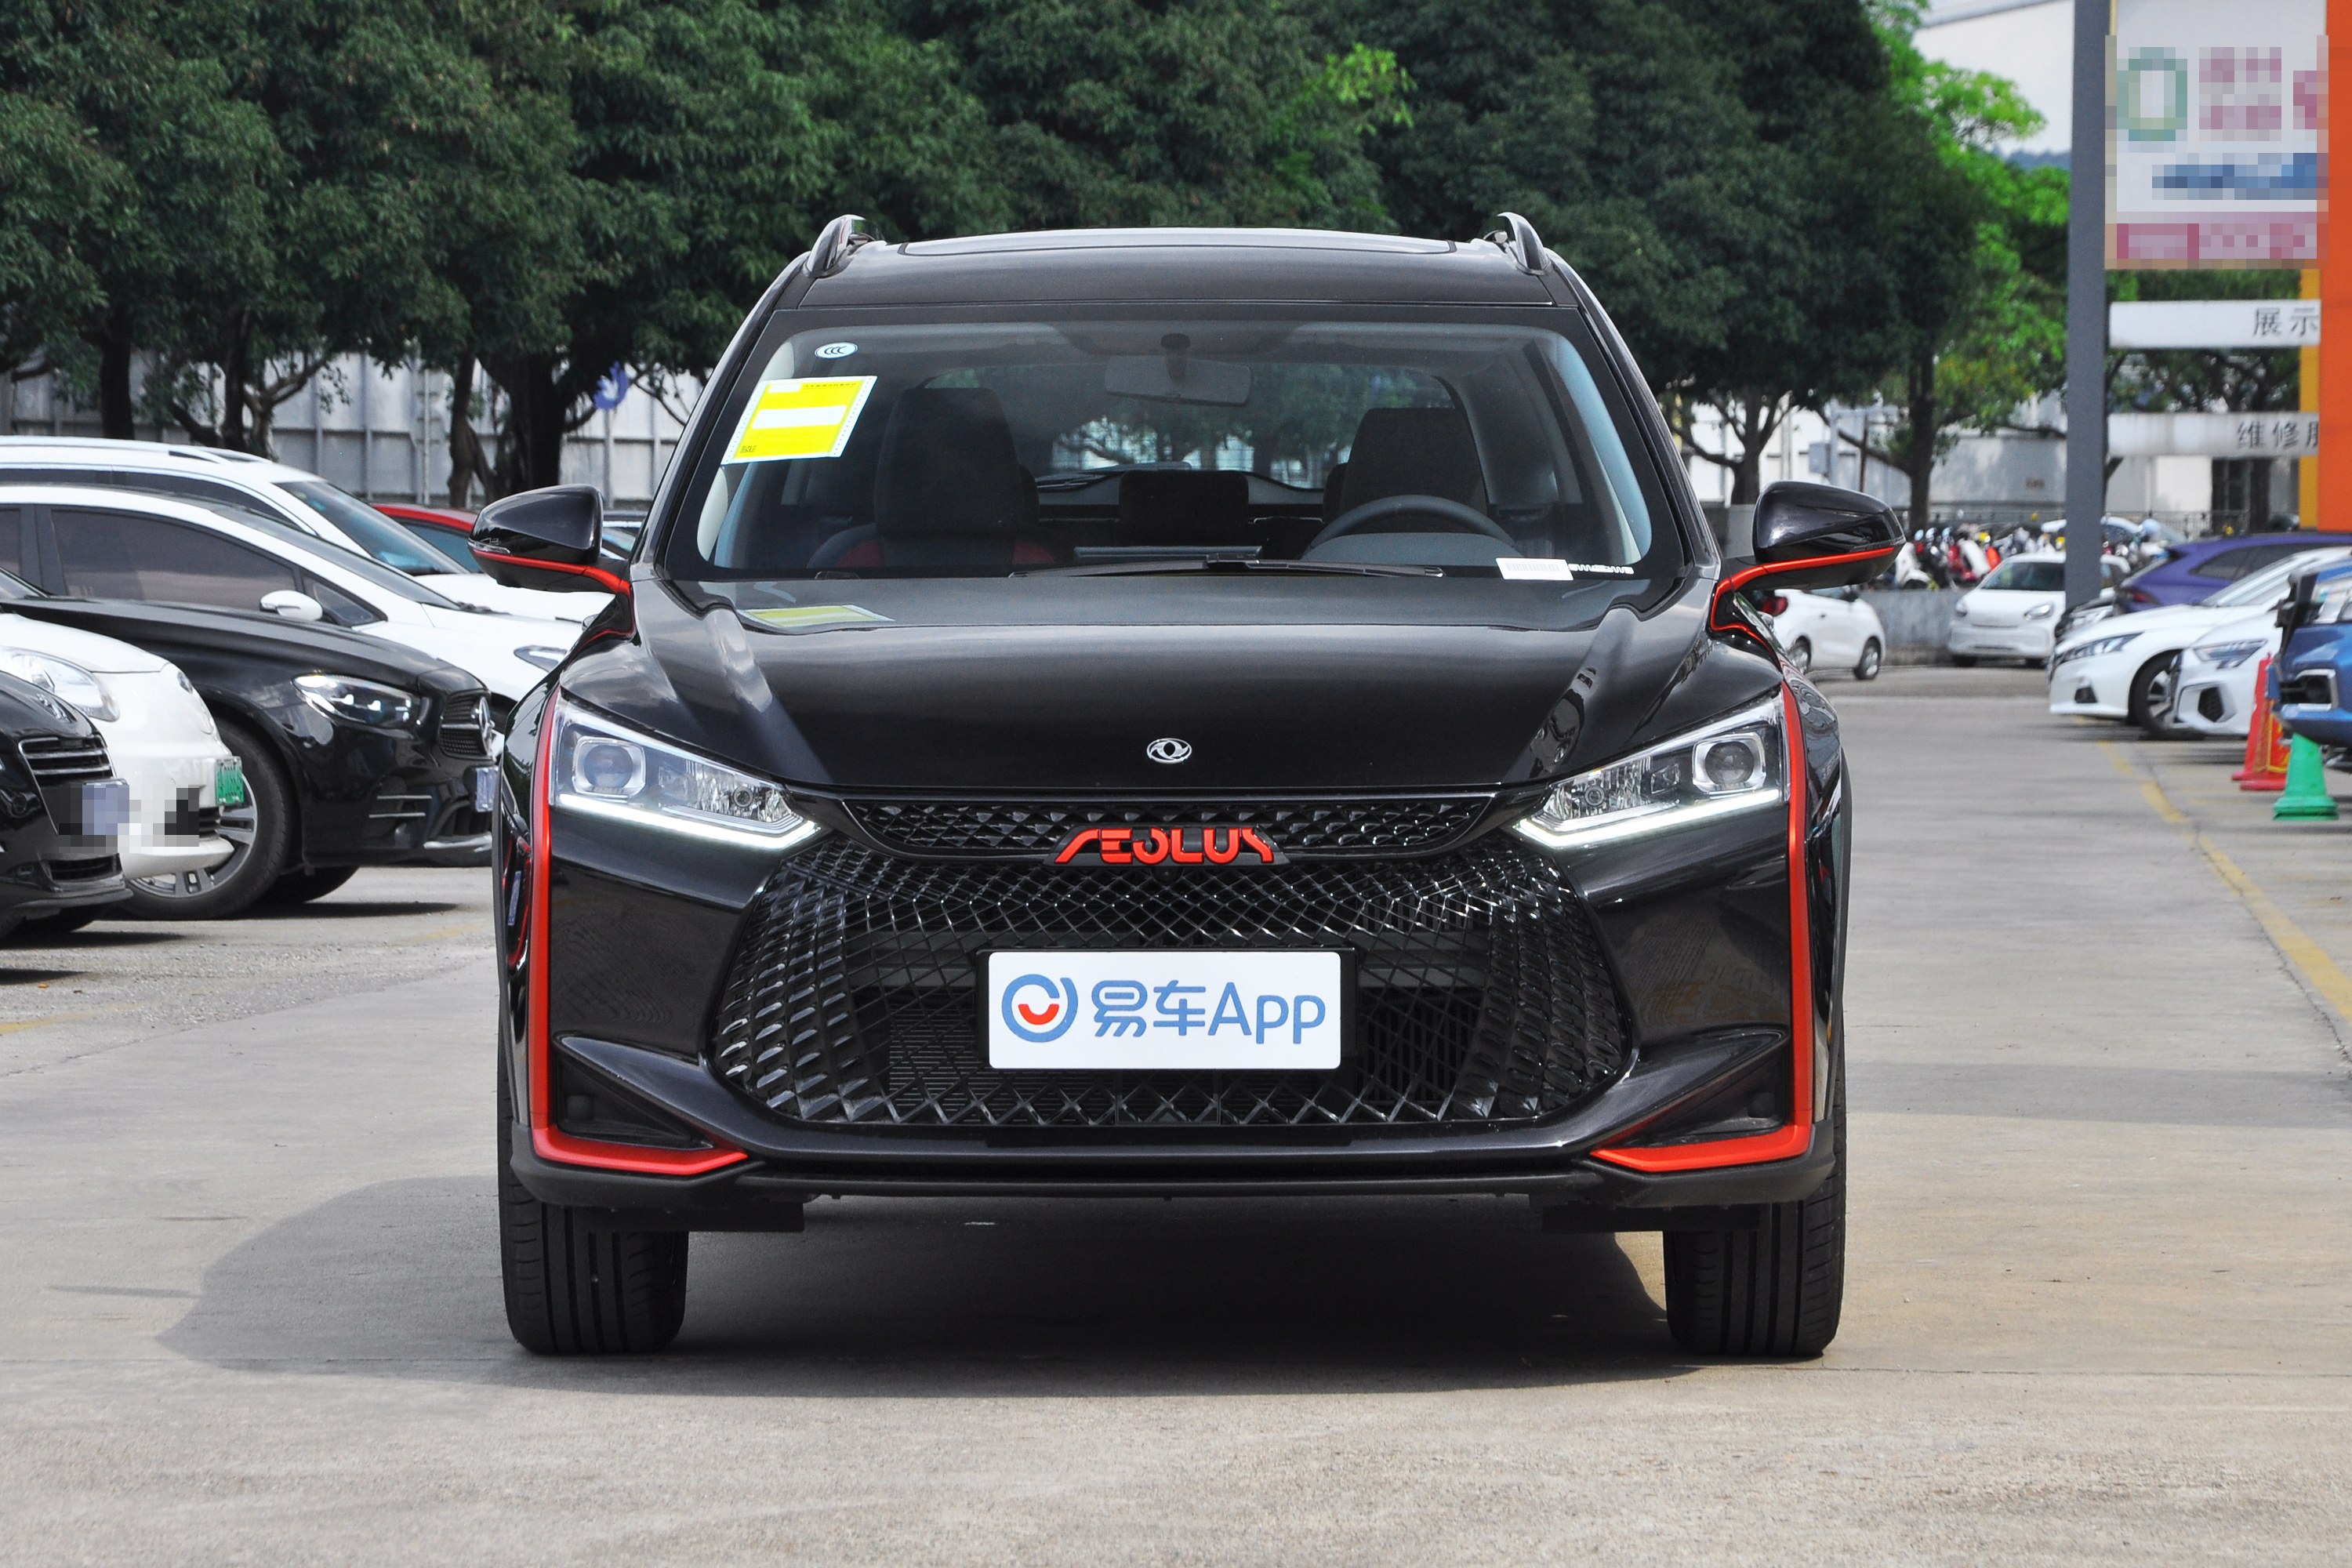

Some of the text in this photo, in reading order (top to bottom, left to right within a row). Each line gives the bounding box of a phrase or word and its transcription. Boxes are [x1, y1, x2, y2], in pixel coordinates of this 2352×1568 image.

[2253, 307, 2320, 336] 展示
[824, 346, 847, 355] CCC
[1091, 980, 1326, 1044] 易车App
